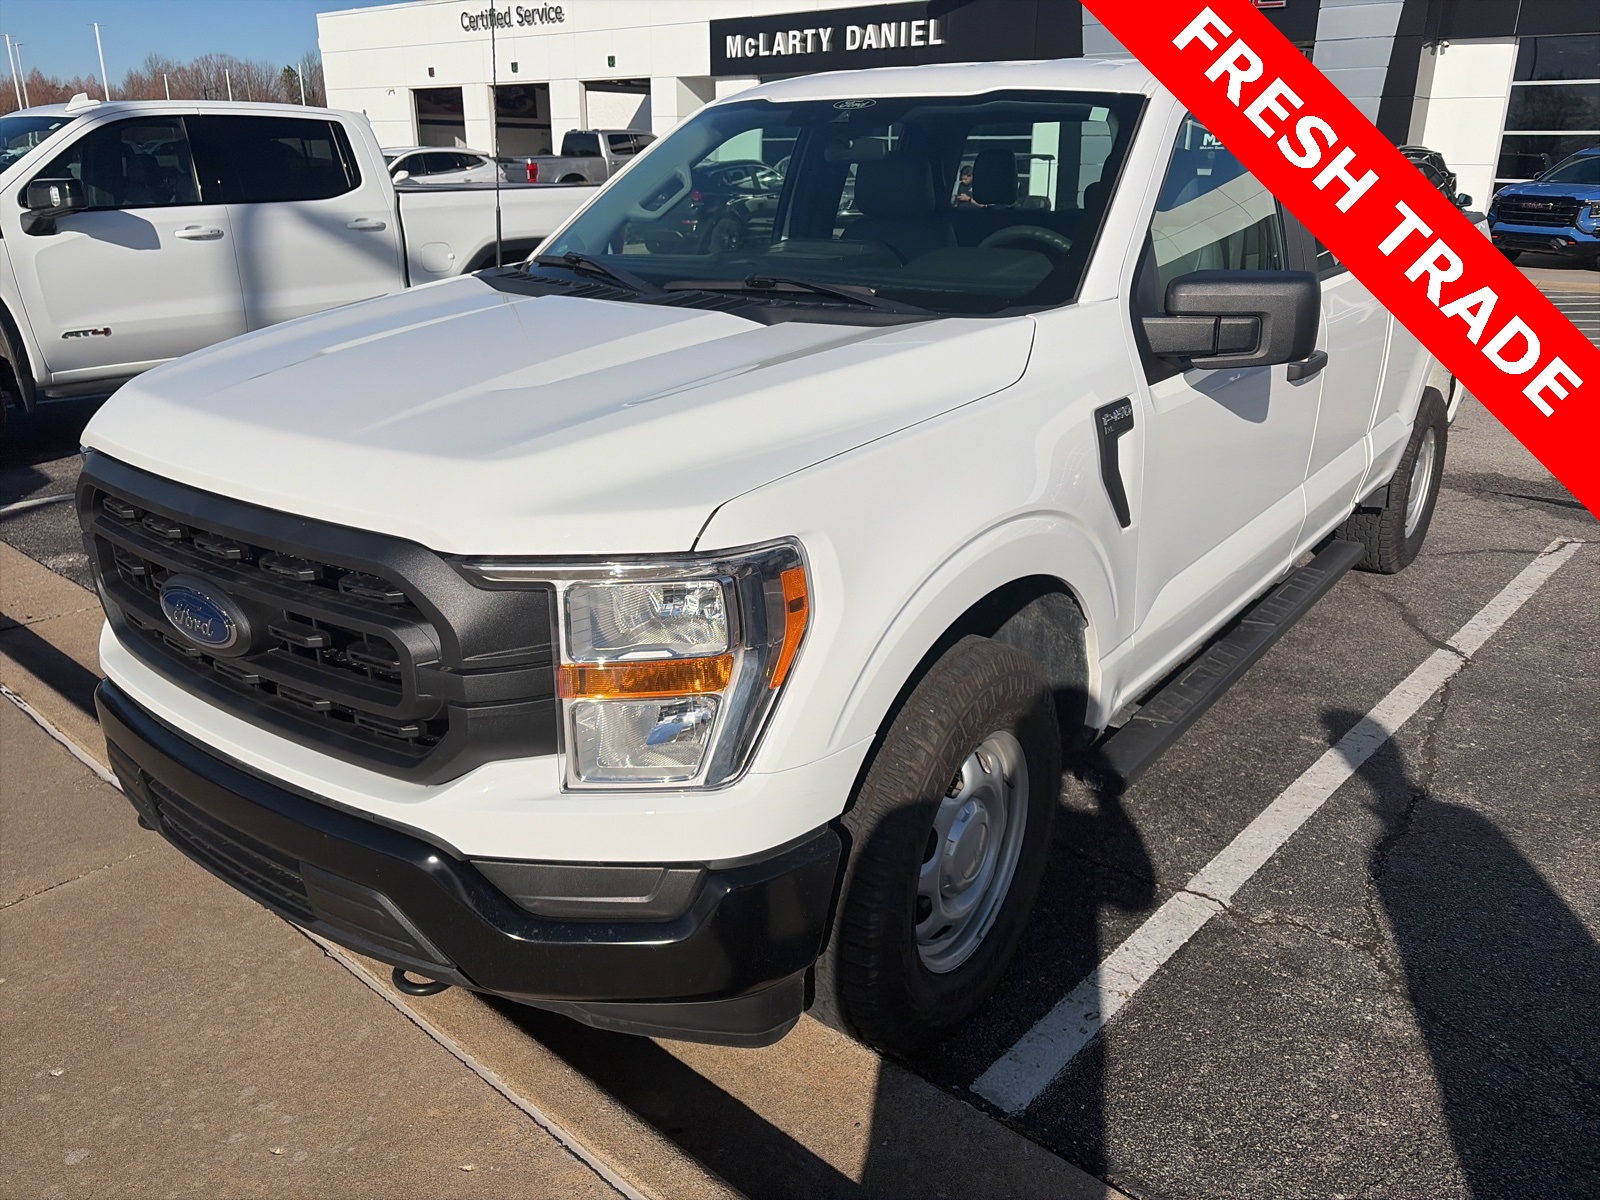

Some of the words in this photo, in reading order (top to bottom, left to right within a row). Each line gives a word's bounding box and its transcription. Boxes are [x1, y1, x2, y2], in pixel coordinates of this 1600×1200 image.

[461, 6, 512, 30] Certified
[516, 2, 564, 25] Service
[726, 27, 833, 59] McLARTY
[845, 18, 945, 51] DANIEL
[173, 599, 214, 637] Ford
